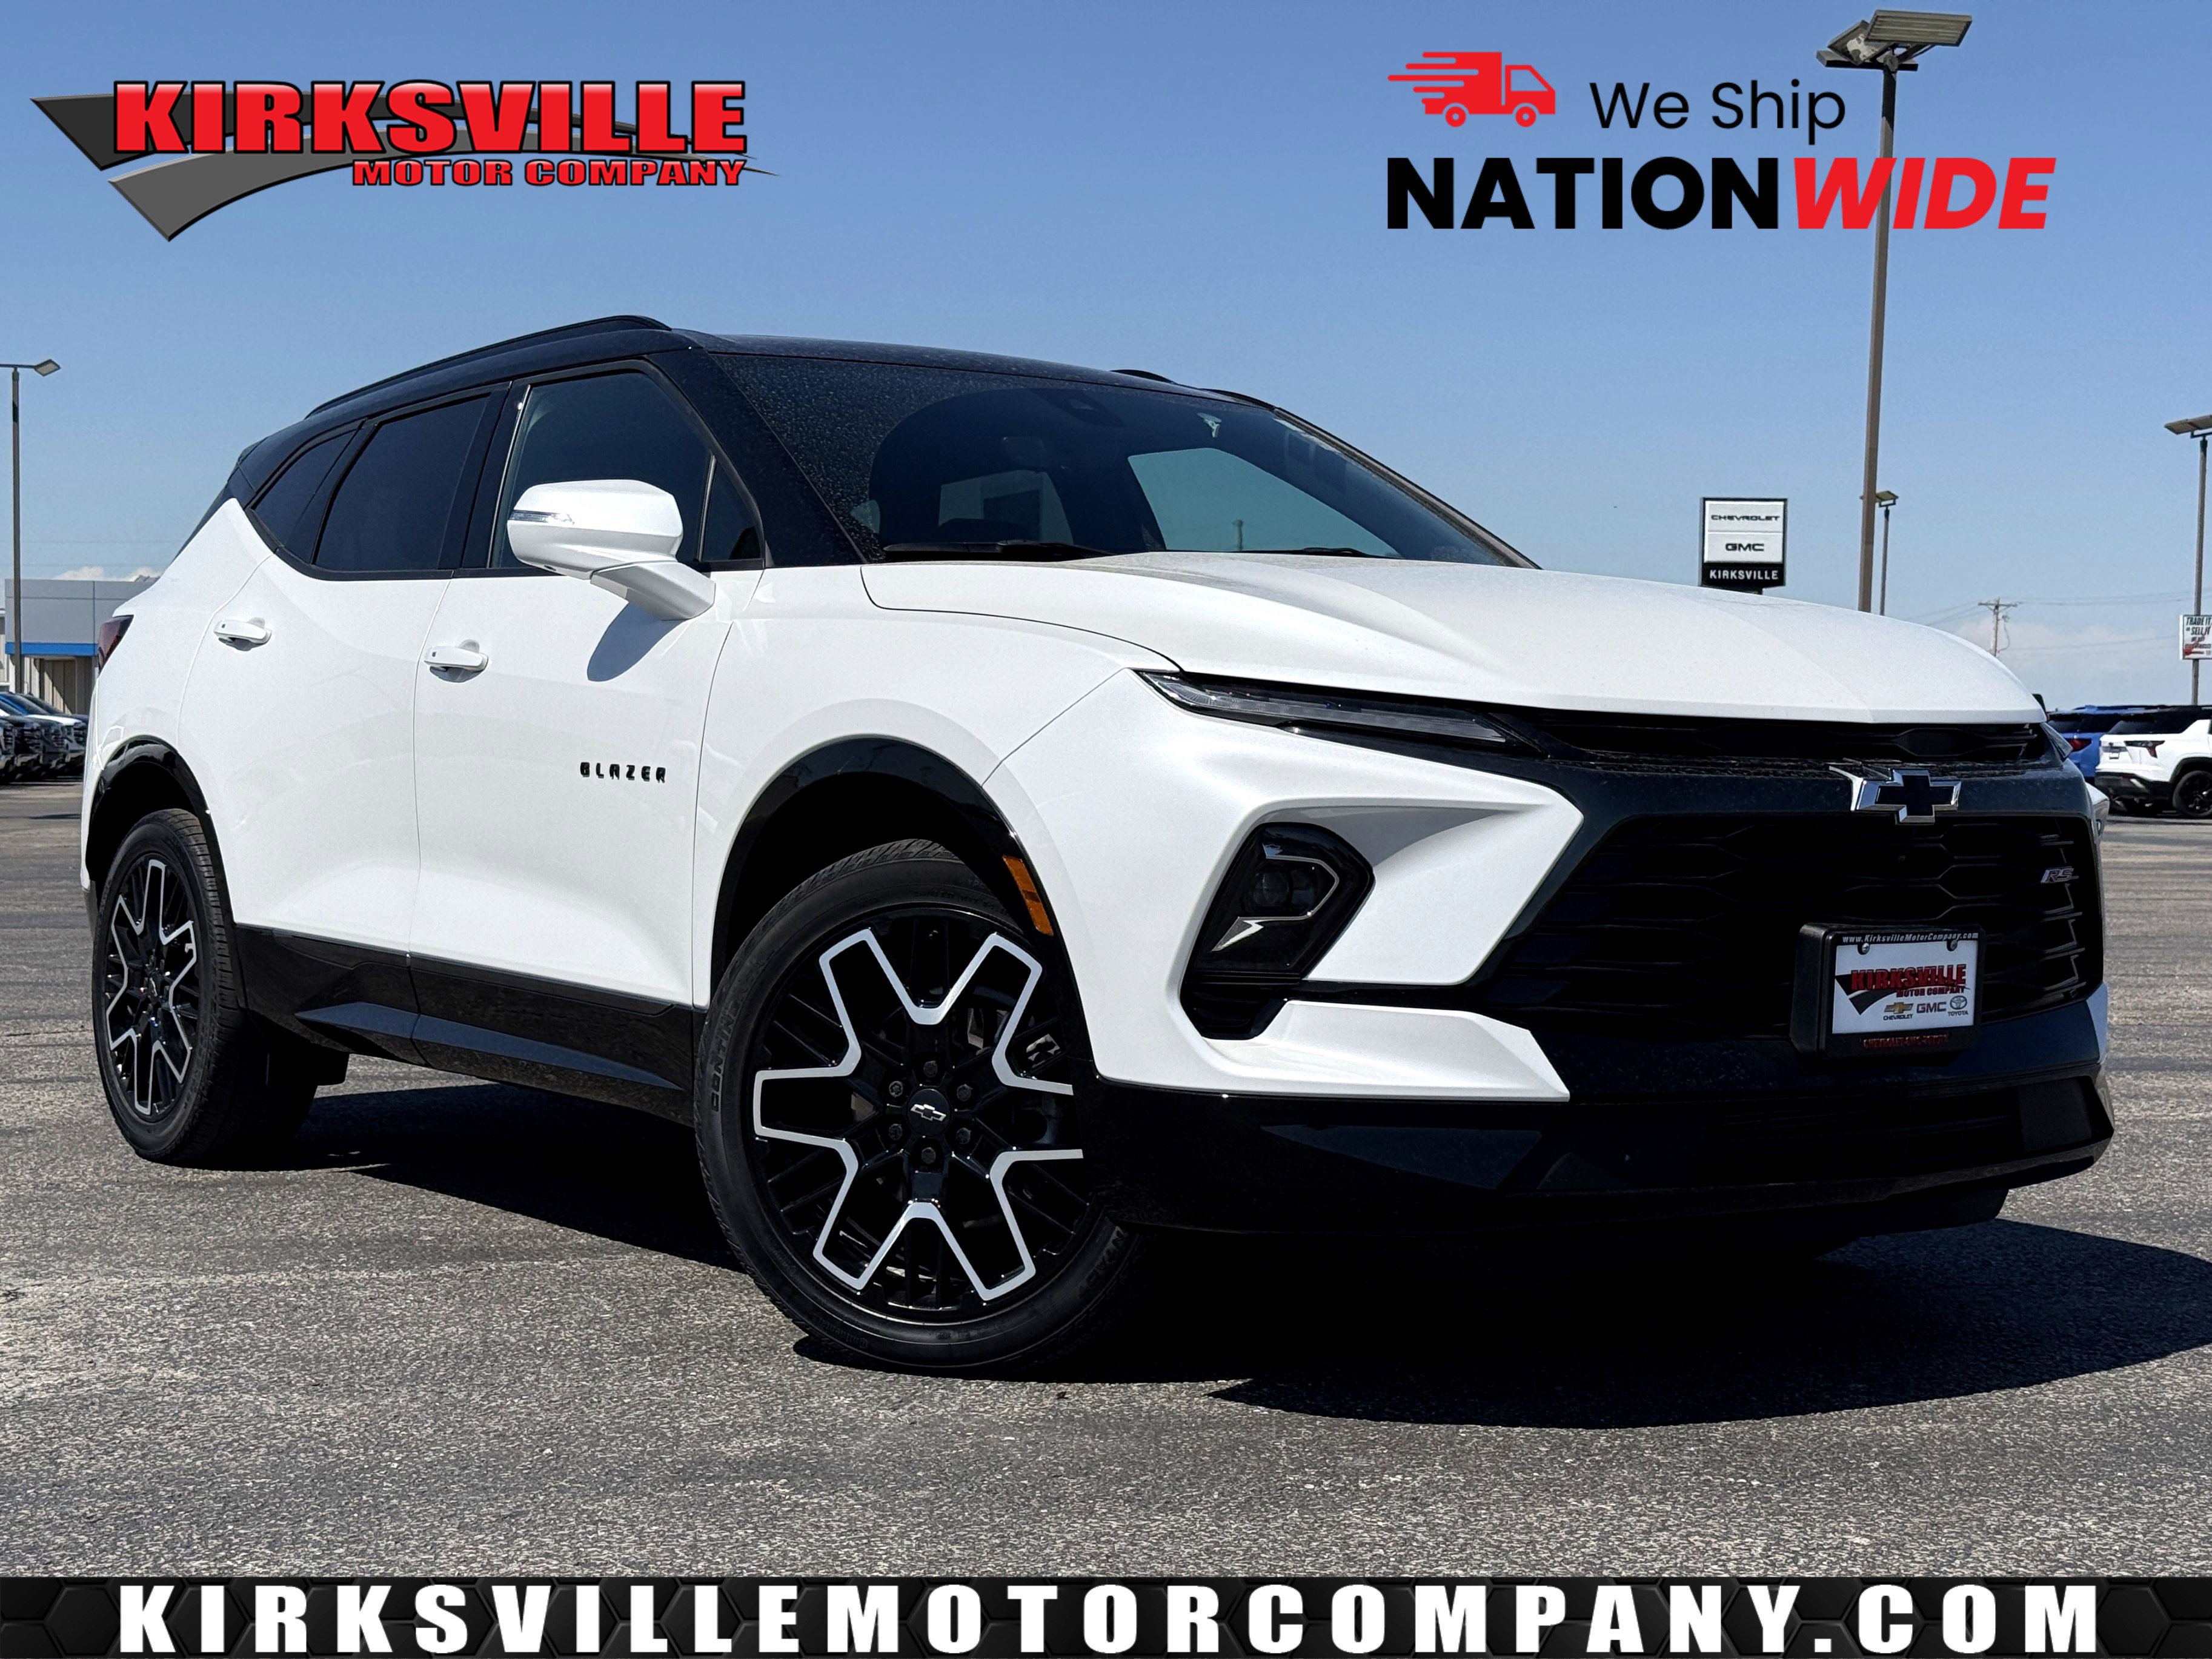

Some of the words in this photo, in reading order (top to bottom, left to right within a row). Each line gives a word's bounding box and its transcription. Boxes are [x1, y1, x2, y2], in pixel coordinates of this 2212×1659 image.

[1725, 543, 1764, 552] GMC
[1709, 570, 1779, 580] KIRKSVILLE
[580, 762, 666, 783] BLAZER
[2041, 866, 2074, 883] RS
[1842, 932, 1979, 943] www.KirksvilleMotorCompany.com
[1850, 963, 1967, 991] KIRKSVILLE
[1896, 988, 1925, 998] MOTOR
[1927, 985, 1964, 996] COMPANY
[1916, 1002, 1947, 1014] GMC
